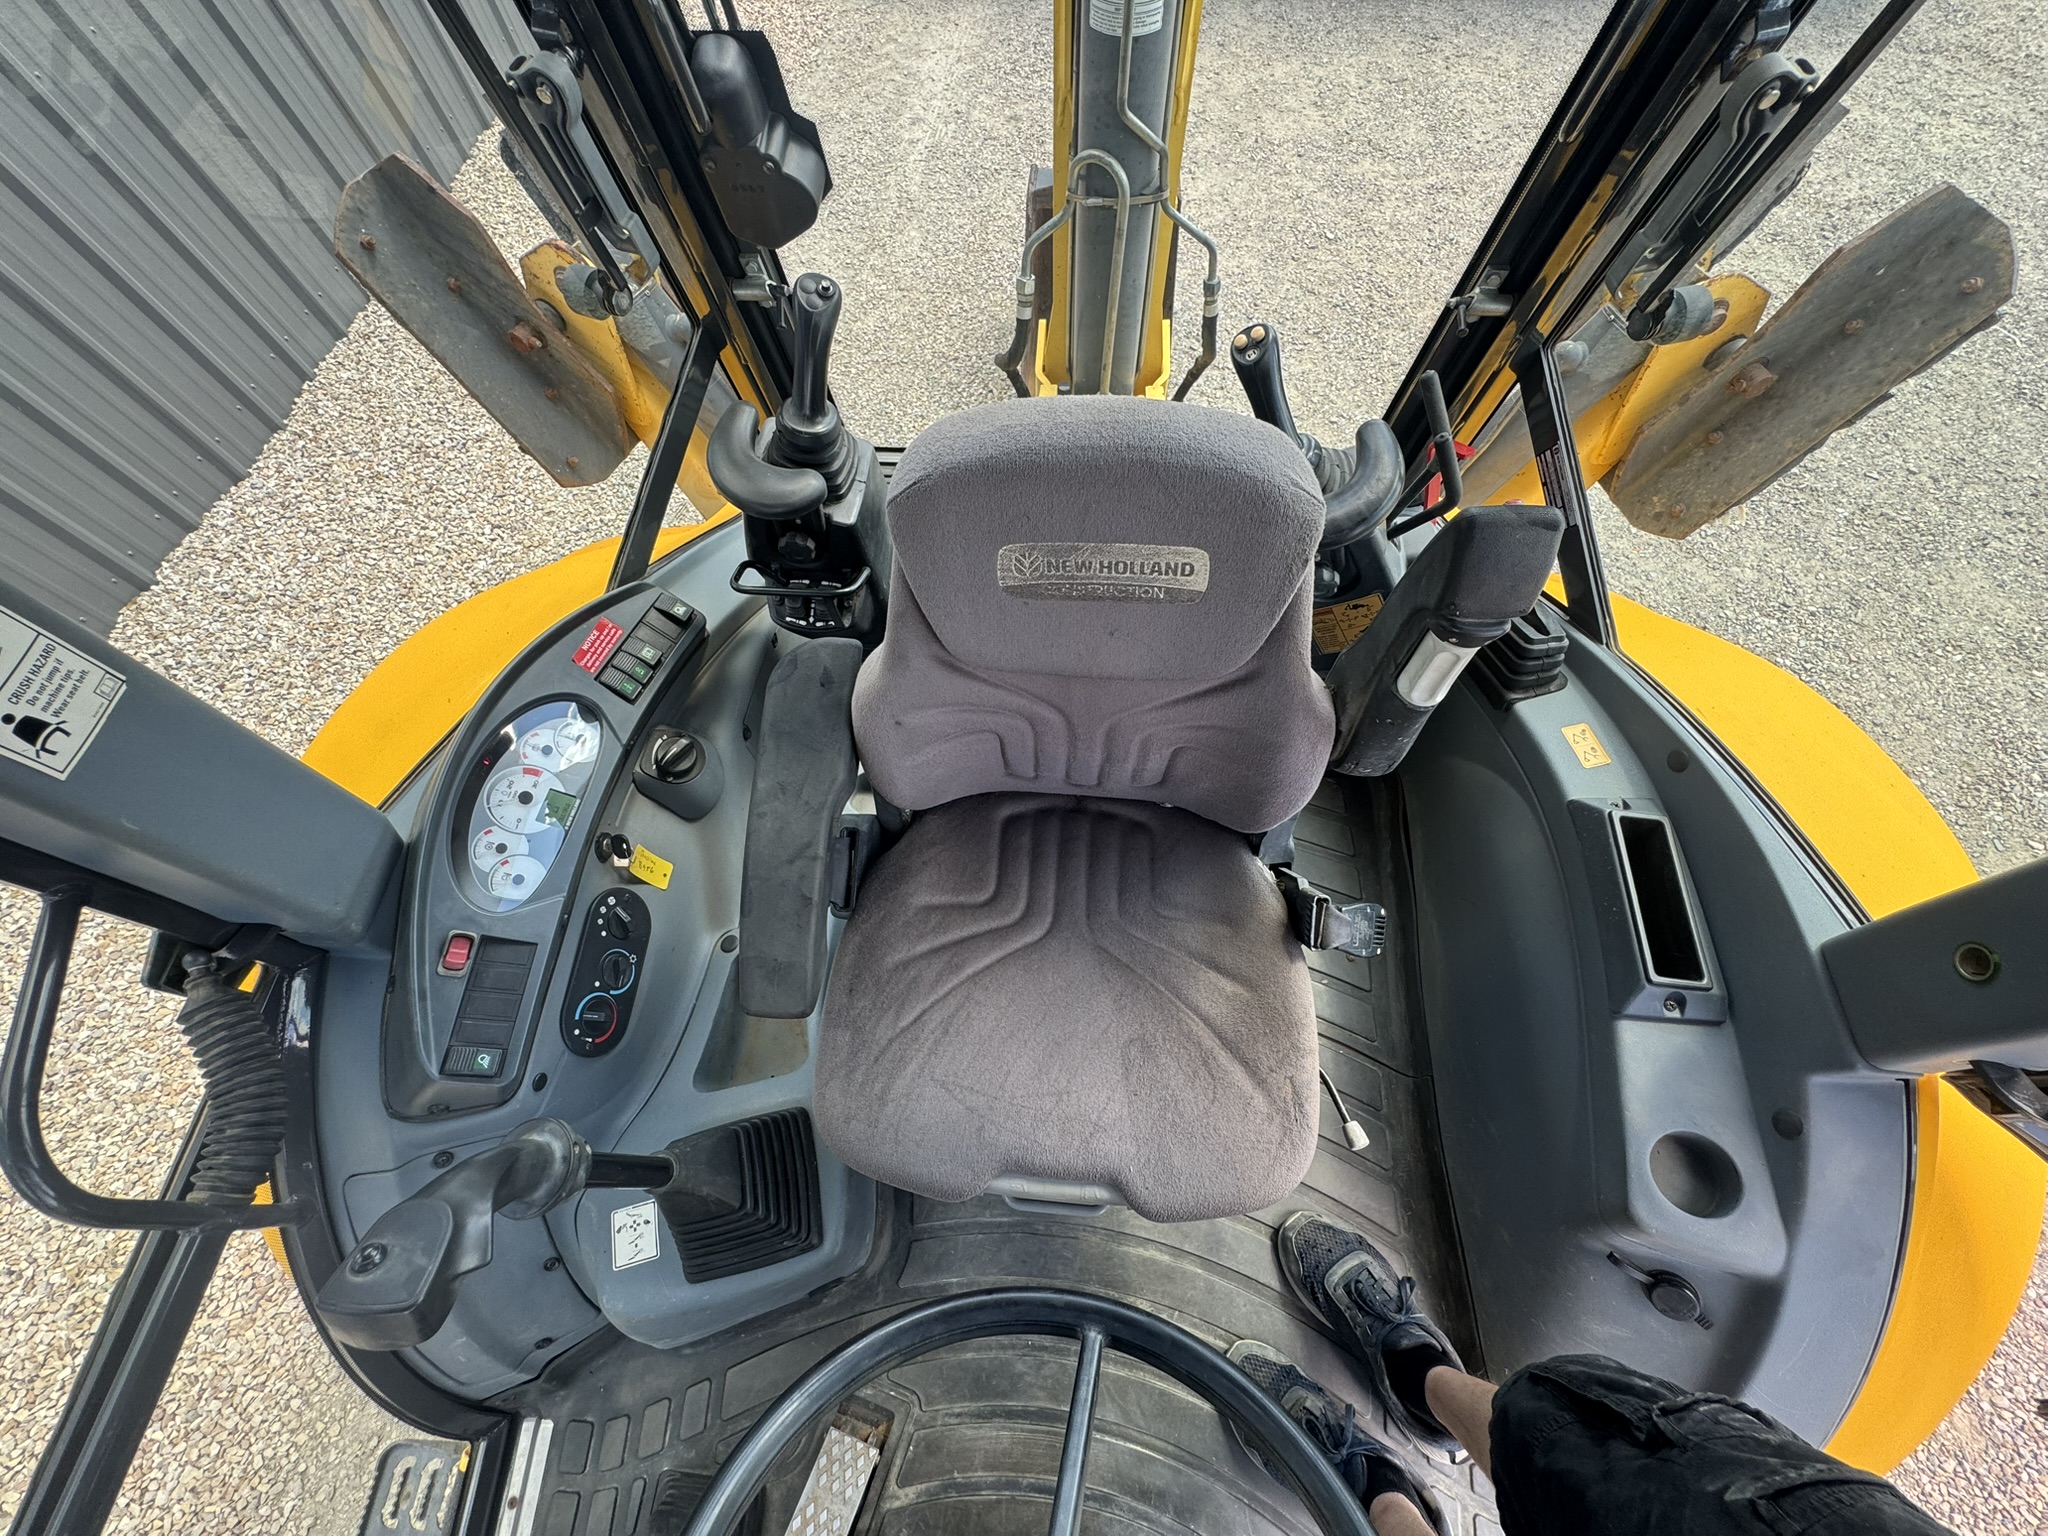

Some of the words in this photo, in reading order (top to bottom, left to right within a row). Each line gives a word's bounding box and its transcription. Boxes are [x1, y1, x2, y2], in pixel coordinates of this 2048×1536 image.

[1044, 560, 1093, 576] NEW
[1098, 560, 1195, 578] HOLLAND
[582, 629, 599, 651] NOTICE
[7, 674, 35, 707] CRUSH
[28, 642, 56, 678] HAZARD
[26, 693, 40, 707] Do
[34, 682, 48, 696] not
[41, 664, 62, 685] jump
[53, 657, 64, 666] if
[39, 681, 65, 713] machine
[60, 666, 76, 684] tips.
[50, 697, 70, 720] Wear
[65, 683, 80, 700] seat
[73, 667, 90, 685] belt.
[507, 780, 514, 790] 20
[532, 779, 540, 789] 30
